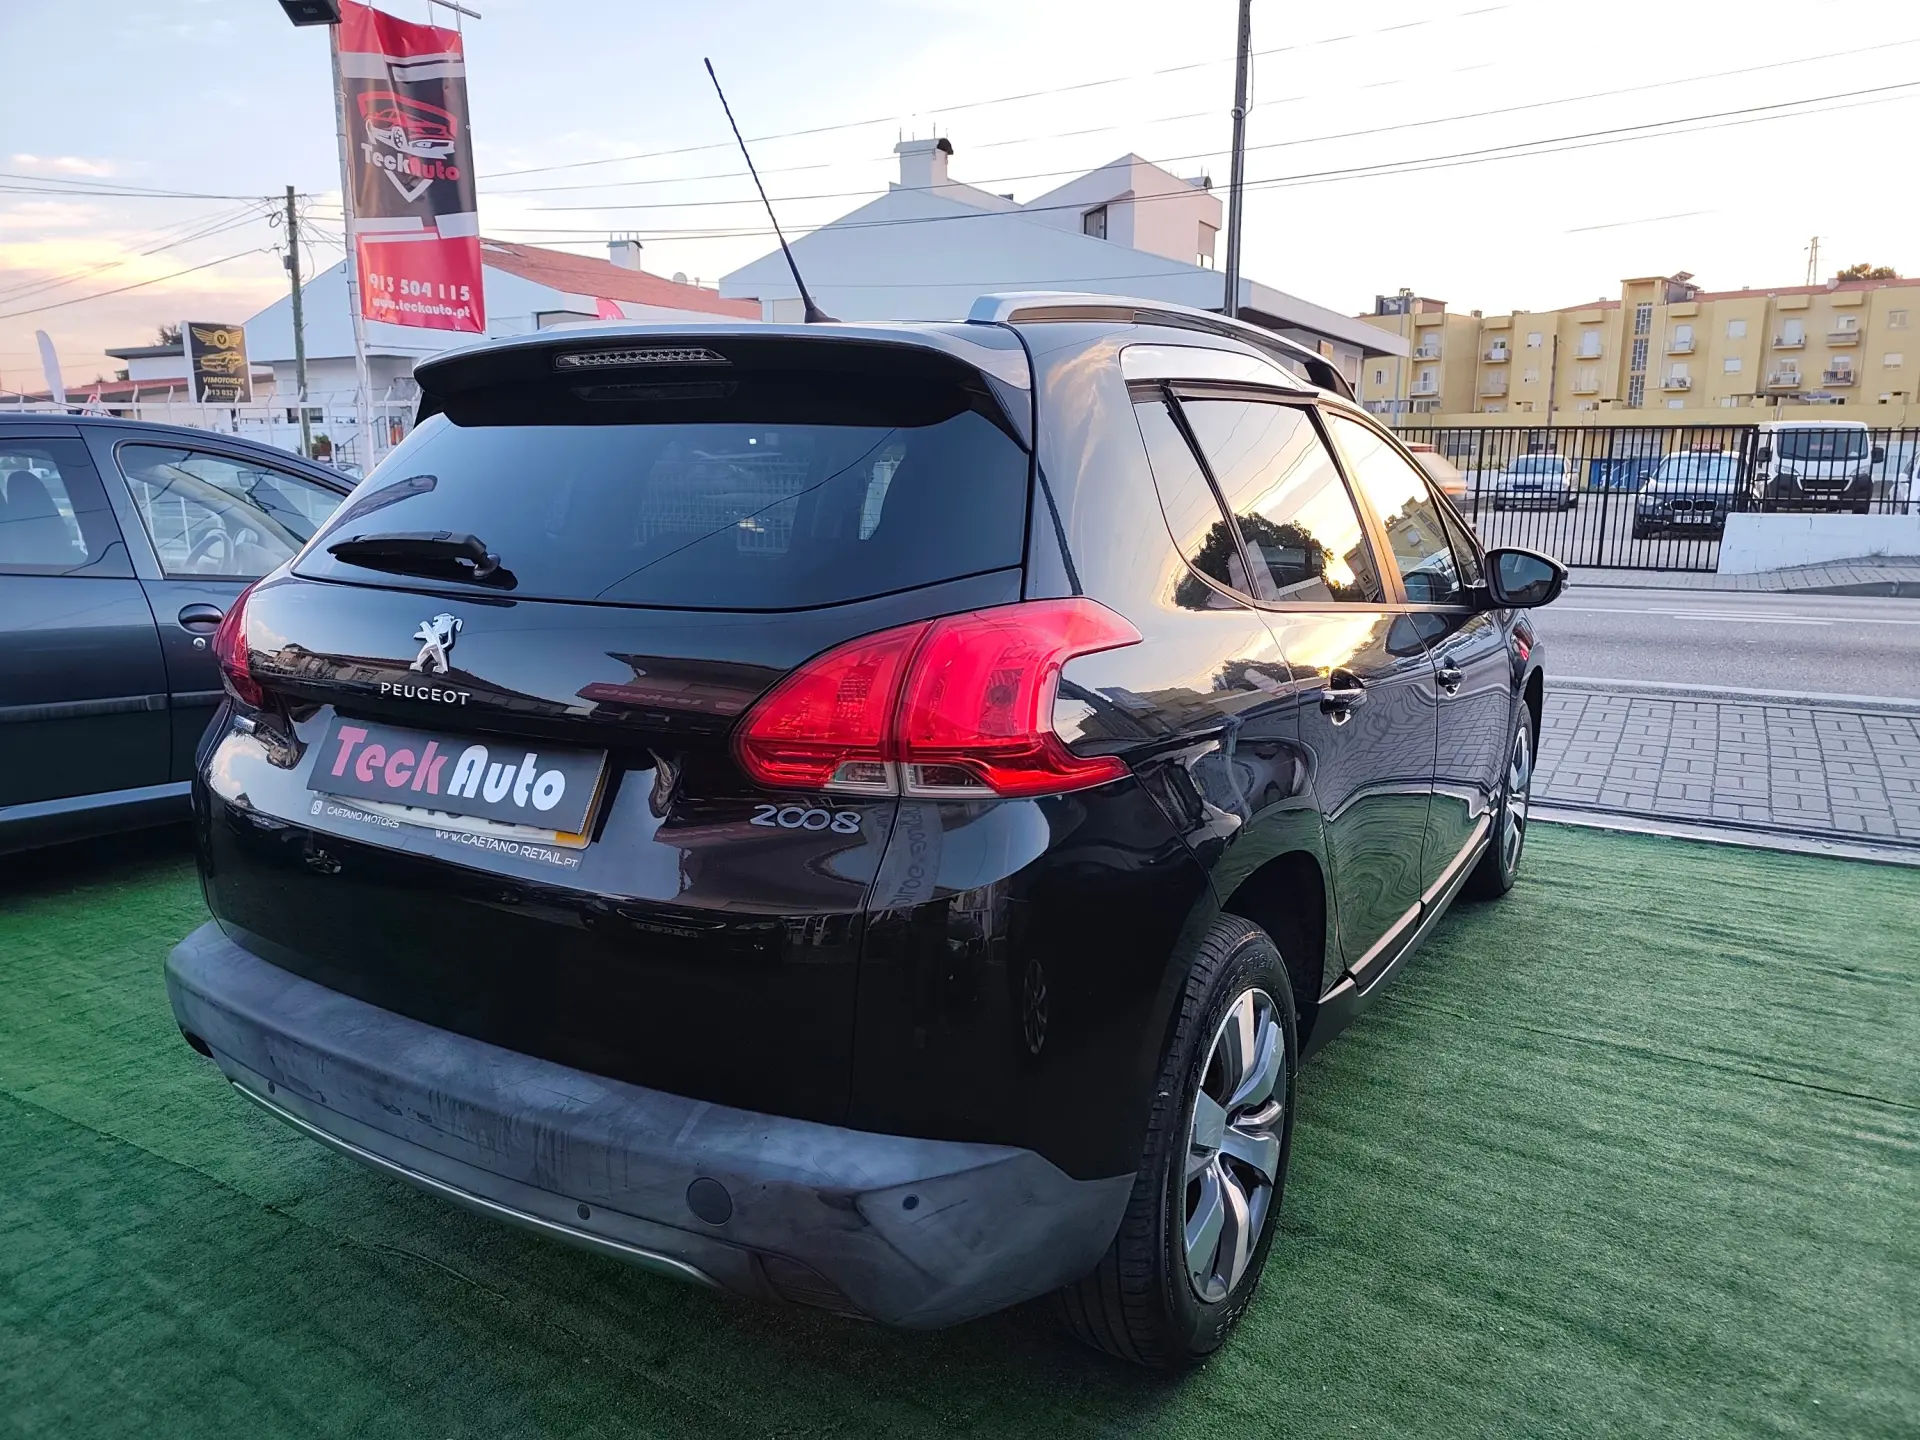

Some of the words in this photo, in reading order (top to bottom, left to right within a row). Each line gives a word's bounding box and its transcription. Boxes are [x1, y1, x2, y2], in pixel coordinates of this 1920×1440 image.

[369, 273, 395, 293] 913
[400, 278, 432, 298] 504
[372, 296, 471, 319] www.teckauto.pt
[380, 682, 471, 705] PEUGEOT
[327, 806, 363, 820] CAETANO
[362, 813, 400, 828] MOTORS
[750, 804, 861, 834] 2008
